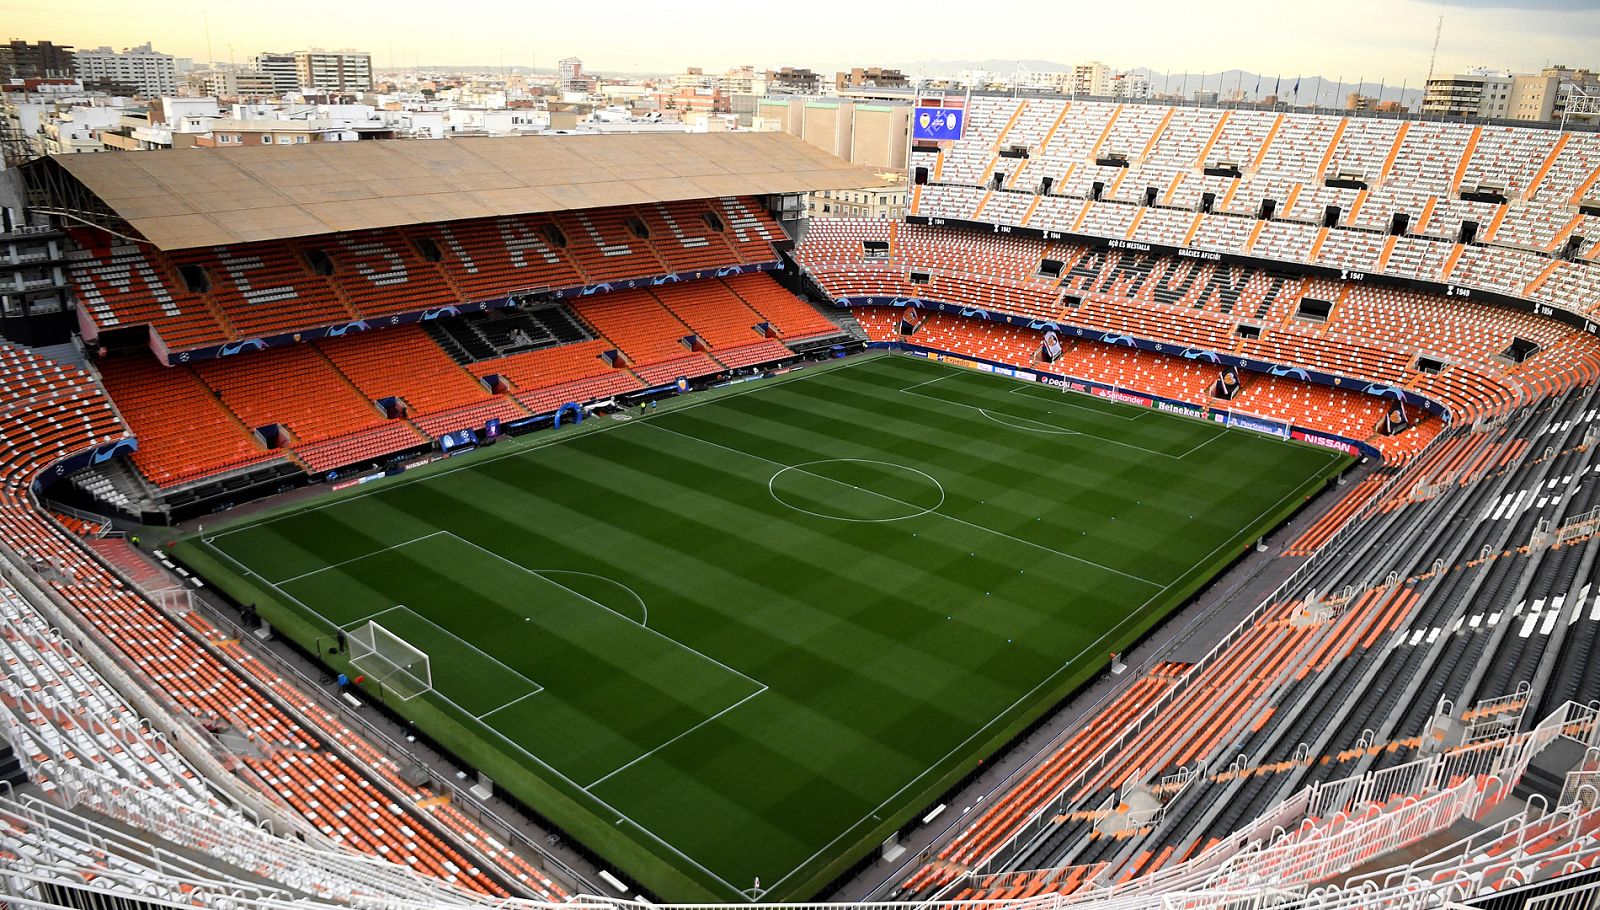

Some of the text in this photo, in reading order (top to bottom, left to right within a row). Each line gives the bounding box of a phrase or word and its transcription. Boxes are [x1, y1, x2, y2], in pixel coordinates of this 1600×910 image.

[1126, 243, 1151, 251] MESTALLA
[63, 196, 773, 326] MESTALLA
[1350, 272, 1364, 280] 1947
[945, 357, 970, 367] Expedia
[1048, 378, 1070, 388] pepsi
[1106, 390, 1145, 405] Santander
[1158, 401, 1201, 418] Heineken
[1240, 420, 1273, 433] PlayStation
[1304, 433, 1351, 452] NISSAN
[405, 459, 429, 470] NISSAN
